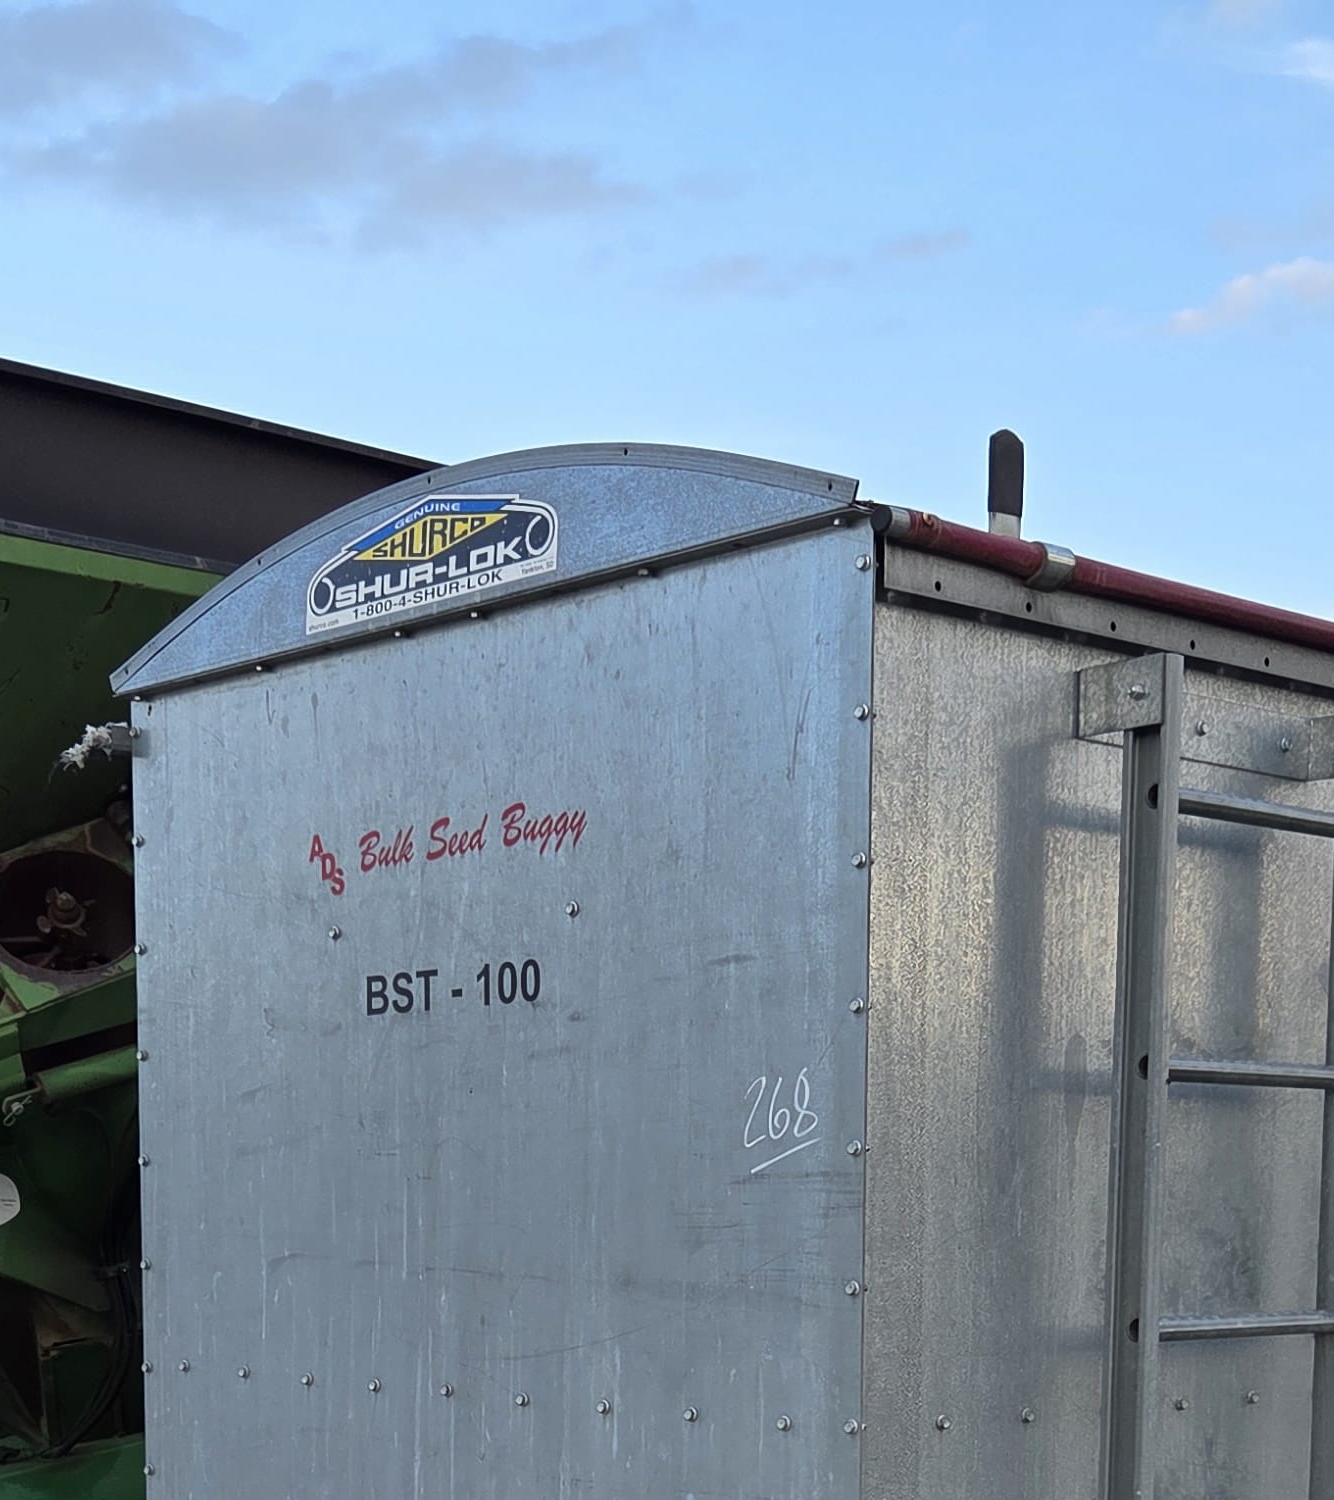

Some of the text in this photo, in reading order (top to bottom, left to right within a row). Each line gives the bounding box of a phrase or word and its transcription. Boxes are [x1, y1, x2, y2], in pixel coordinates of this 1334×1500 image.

[371, 516, 486, 559] SHURCO
[394, 502, 461, 530] GENUINE
[334, 535, 523, 608] SHUR-LOK
[352, 568, 503, 621] 1-800-4-SHUR-LOK
[358, 825, 415, 873] Bulk
[426, 812, 489, 861] Seed
[501, 801, 588, 857] Buggy
[366, 968, 439, 1017] BST
[476, 958, 541, 1007] 100
[744, 1067, 819, 1148] 268
